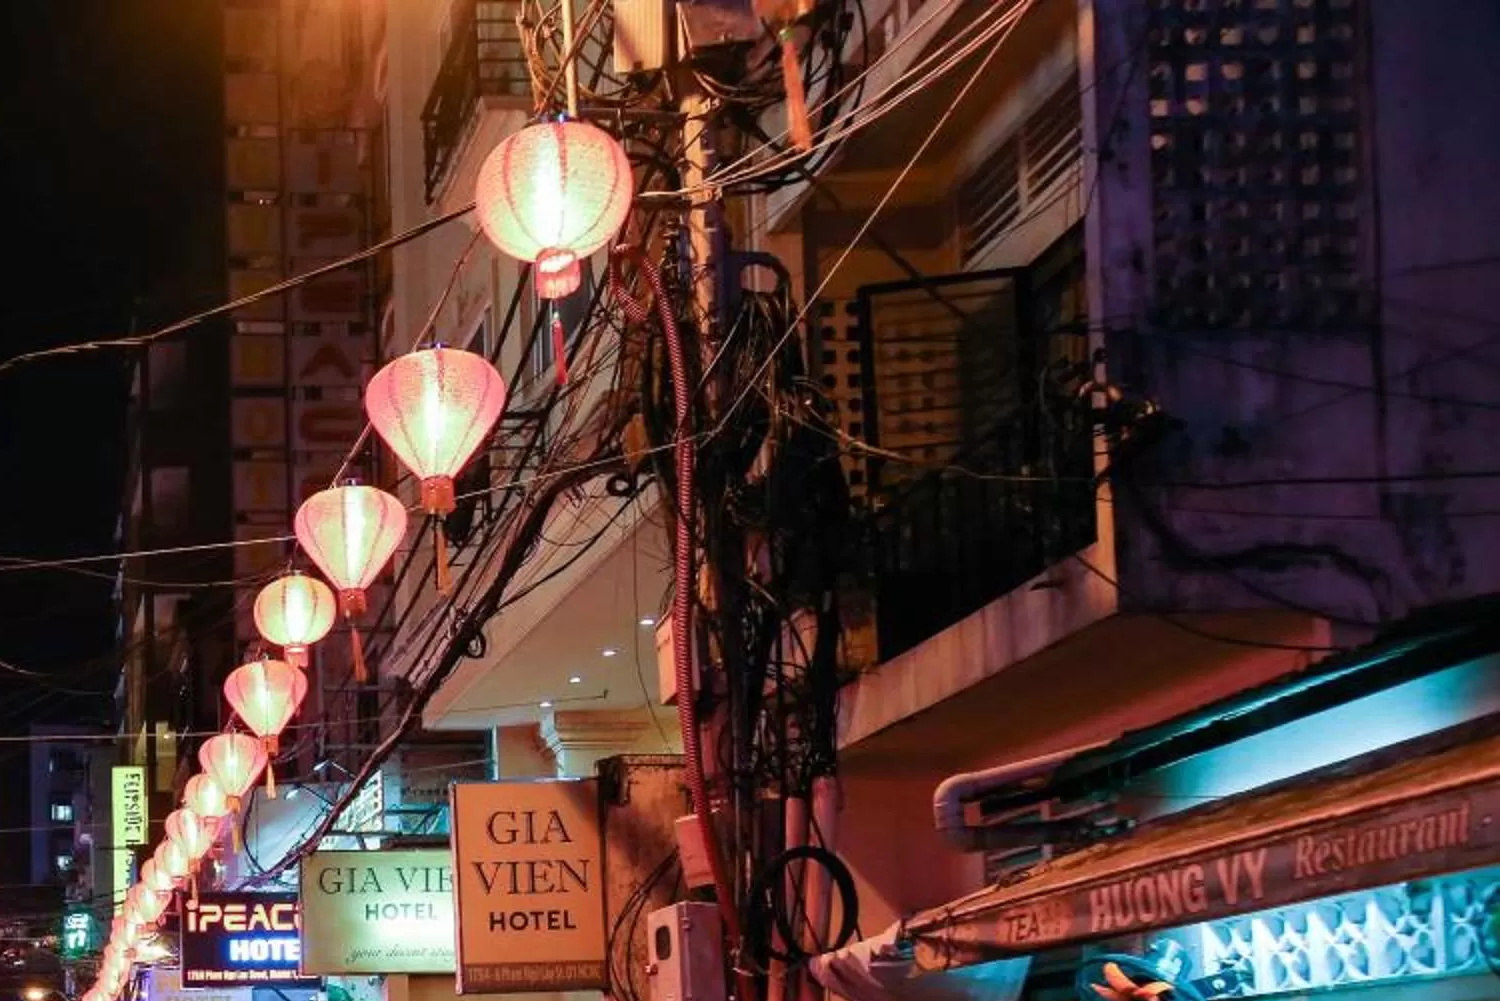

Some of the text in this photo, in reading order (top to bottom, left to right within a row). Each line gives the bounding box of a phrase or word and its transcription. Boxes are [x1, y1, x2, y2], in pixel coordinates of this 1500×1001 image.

[486, 810, 573, 844] GIA
[1295, 802, 1472, 880] Restaurant
[318, 867, 454, 895] GIA VIE
[472, 859, 591, 896] VIEN
[185, 900, 301, 932] iPEAC
[365, 903, 439, 921] HOTEL
[489, 909, 577, 932] HOTEL
[229, 938, 300, 961] HOTE
